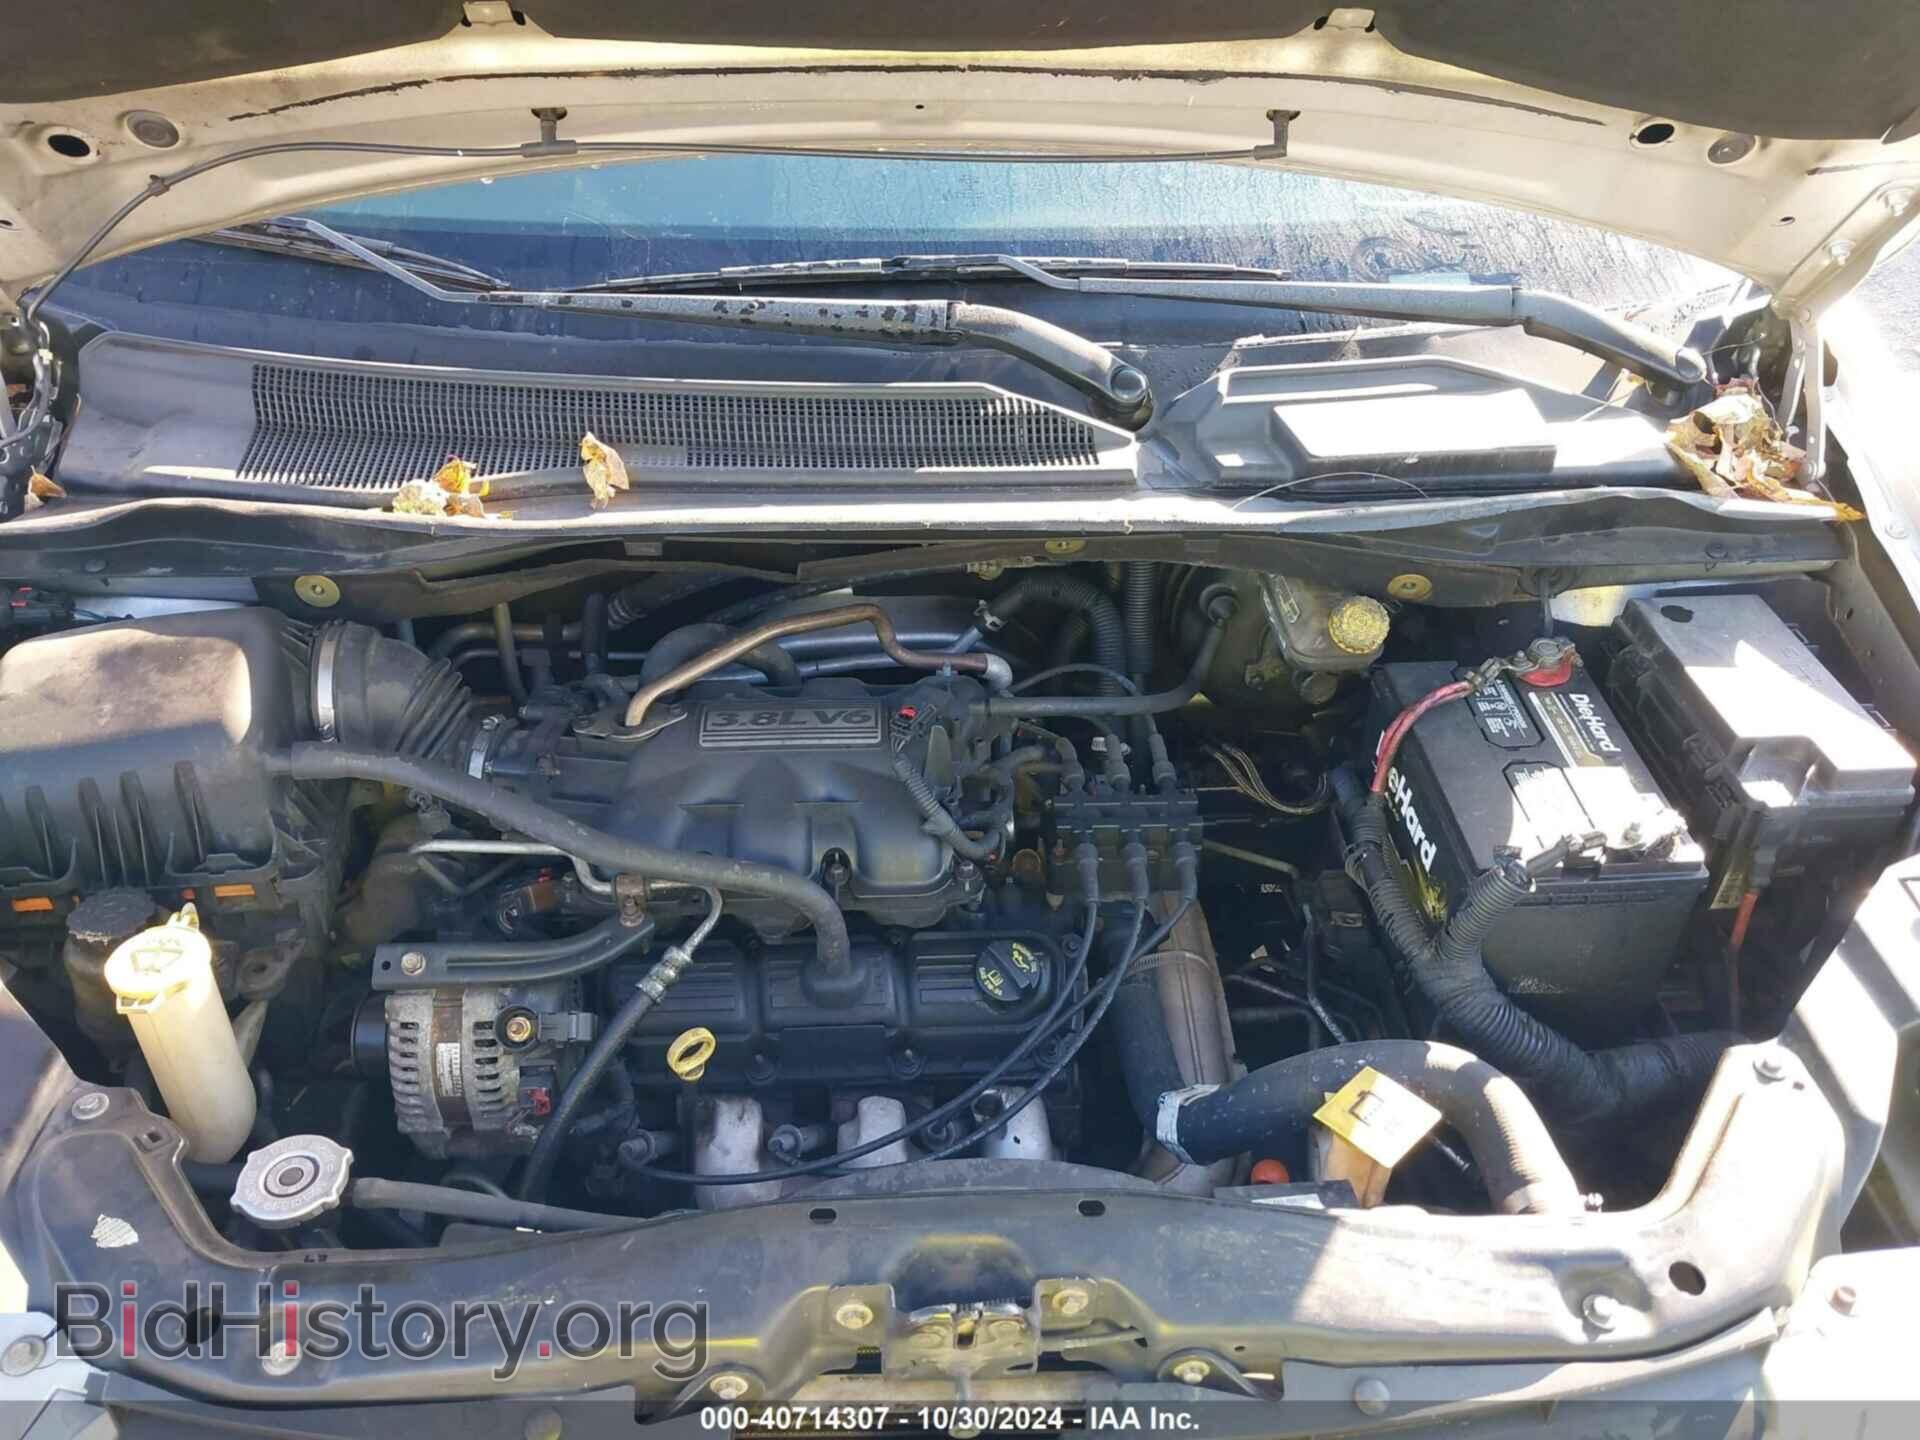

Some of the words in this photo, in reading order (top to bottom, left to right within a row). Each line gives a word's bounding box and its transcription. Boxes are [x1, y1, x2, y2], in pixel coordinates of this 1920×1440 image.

[711, 711, 807, 727] 3.8L
[812, 709, 872, 725] V6
[1569, 692, 1621, 753] DieHard
[1386, 766, 1437, 873] eHard
